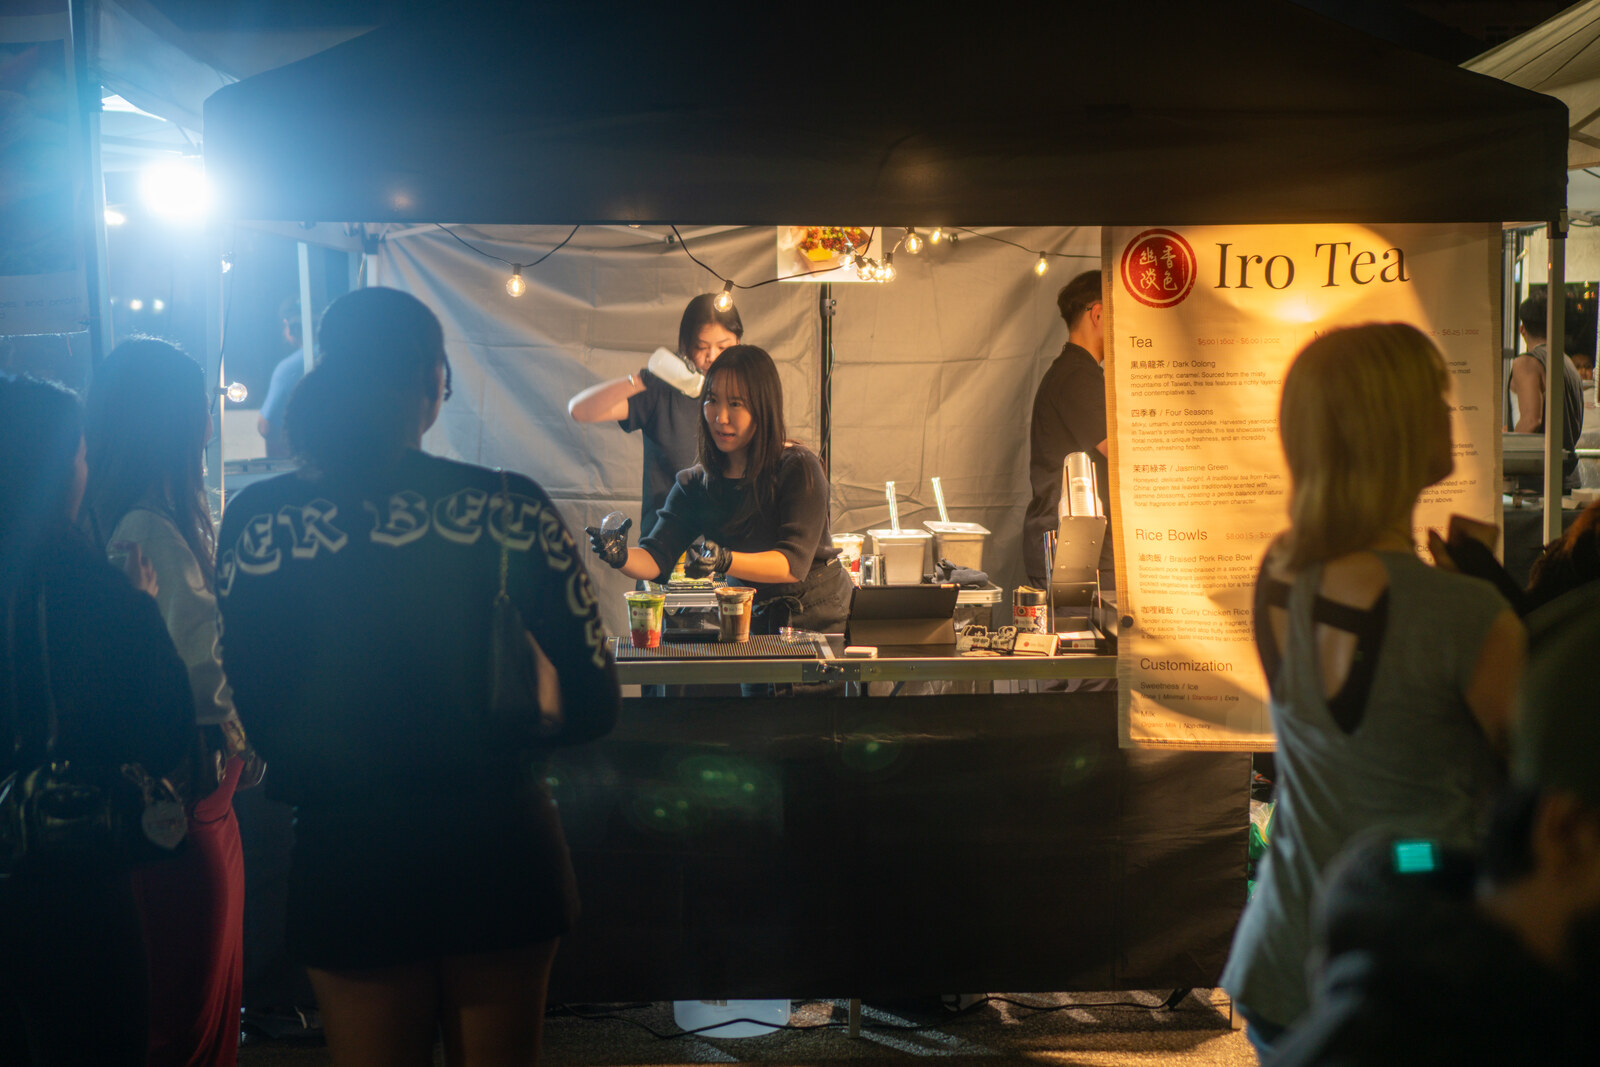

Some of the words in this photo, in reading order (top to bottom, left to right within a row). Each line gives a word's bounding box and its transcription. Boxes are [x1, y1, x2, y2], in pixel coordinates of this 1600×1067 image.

[1214, 242, 1296, 290] Iro
[1314, 241, 1411, 288] Tea
[1128, 336, 1153, 348] Tea
[1172, 360, 1189, 368] Dark
[1191, 360, 1216, 369] Oolong
[1250, 371, 1266, 379] misty
[1131, 409, 1156, 417] 四季春
[1183, 408, 1214, 416] Seasons
[1175, 463, 1206, 472] Jasmine
[1207, 463, 1229, 471] Green
[1217, 490, 1234, 498] gentle
[1135, 528, 1163, 541] Rice
[1168, 528, 1209, 541] Bowls
[1169, 555, 1197, 563] Braised
[1235, 553, 1253, 561] Bowl
[1181, 607, 1200, 617] Curry
[1202, 608, 1231, 617] Chicken
[1233, 607, 1250, 616] Rice
[1211, 627, 1224, 635] fluffy
[1215, 635, 1222, 643] by
[1140, 657, 1234, 672] Customization
[1140, 681, 1180, 690] Sweetness
[1187, 682, 1199, 690] Ice
[1162, 693, 1186, 701] Minimal
